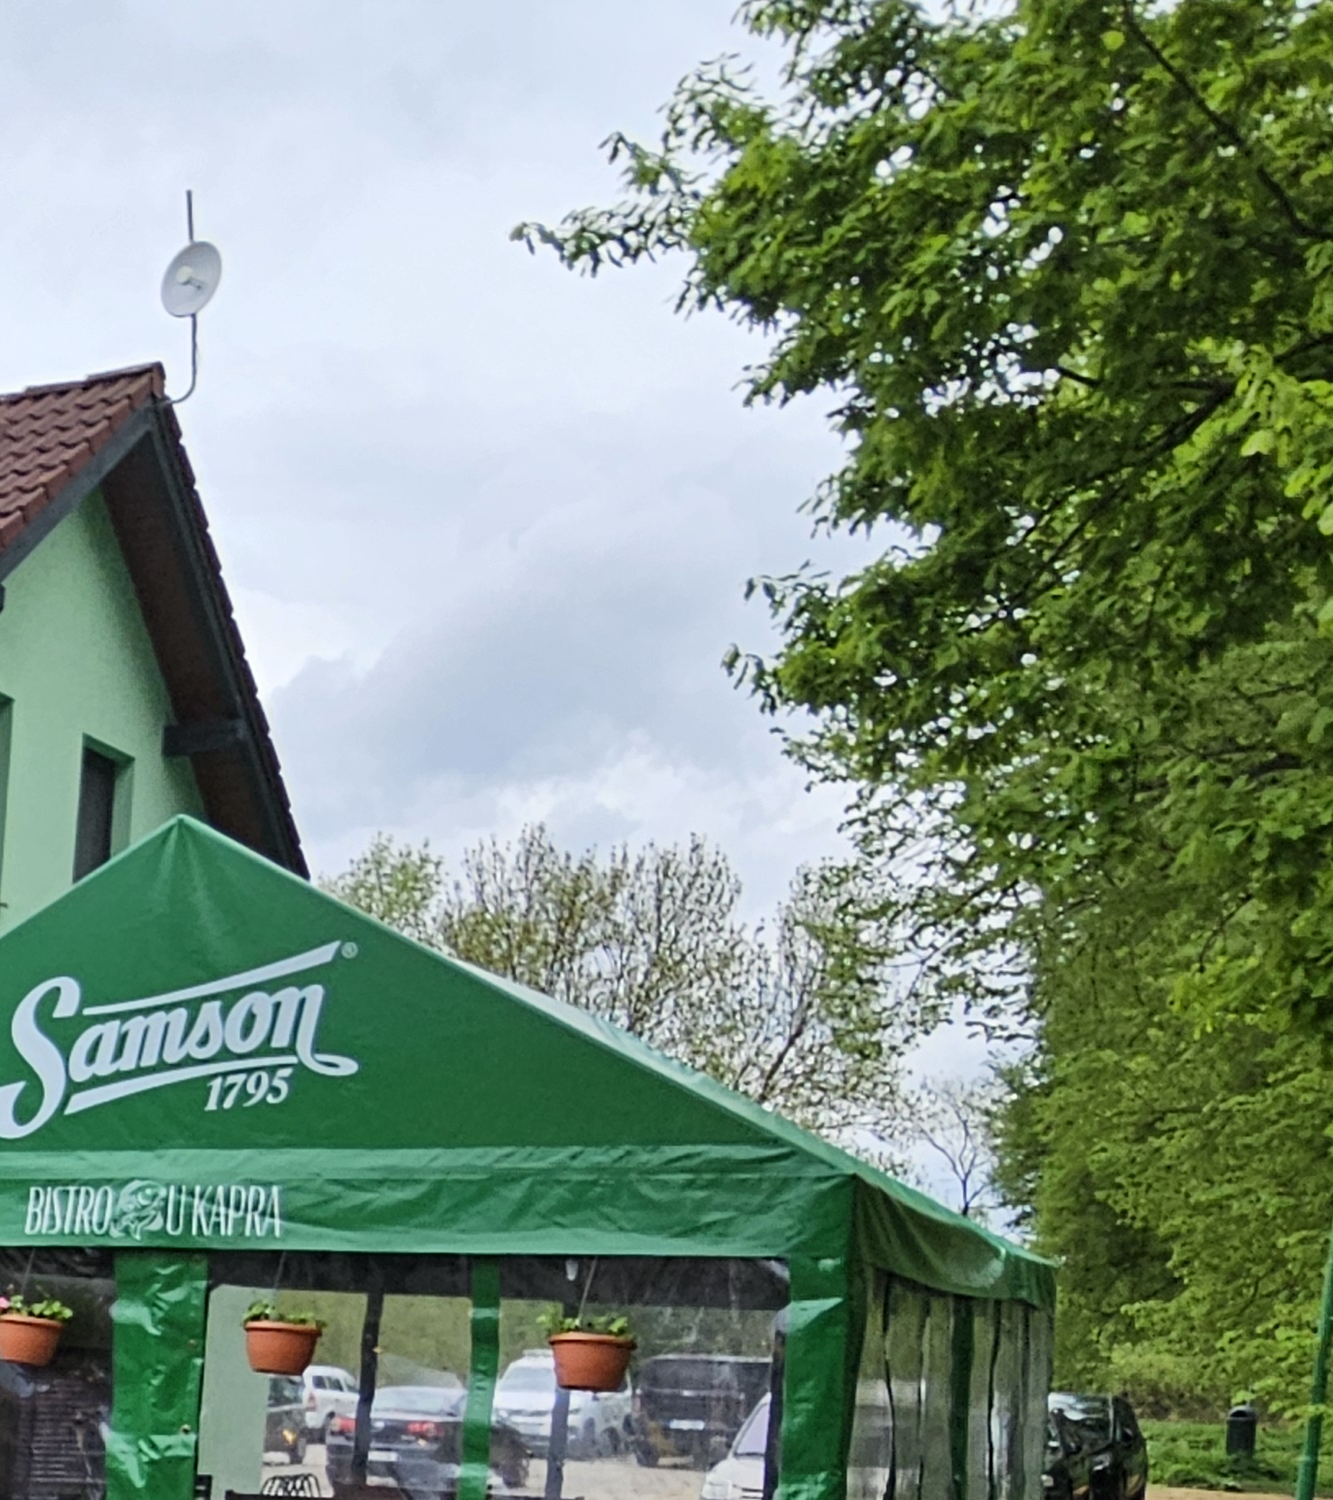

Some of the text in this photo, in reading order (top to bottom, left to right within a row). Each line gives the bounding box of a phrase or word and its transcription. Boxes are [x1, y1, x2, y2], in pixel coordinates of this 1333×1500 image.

[203, 1068, 294, 1112] 1795
[24, 1184, 284, 1239] BISTRO U KAPRA
